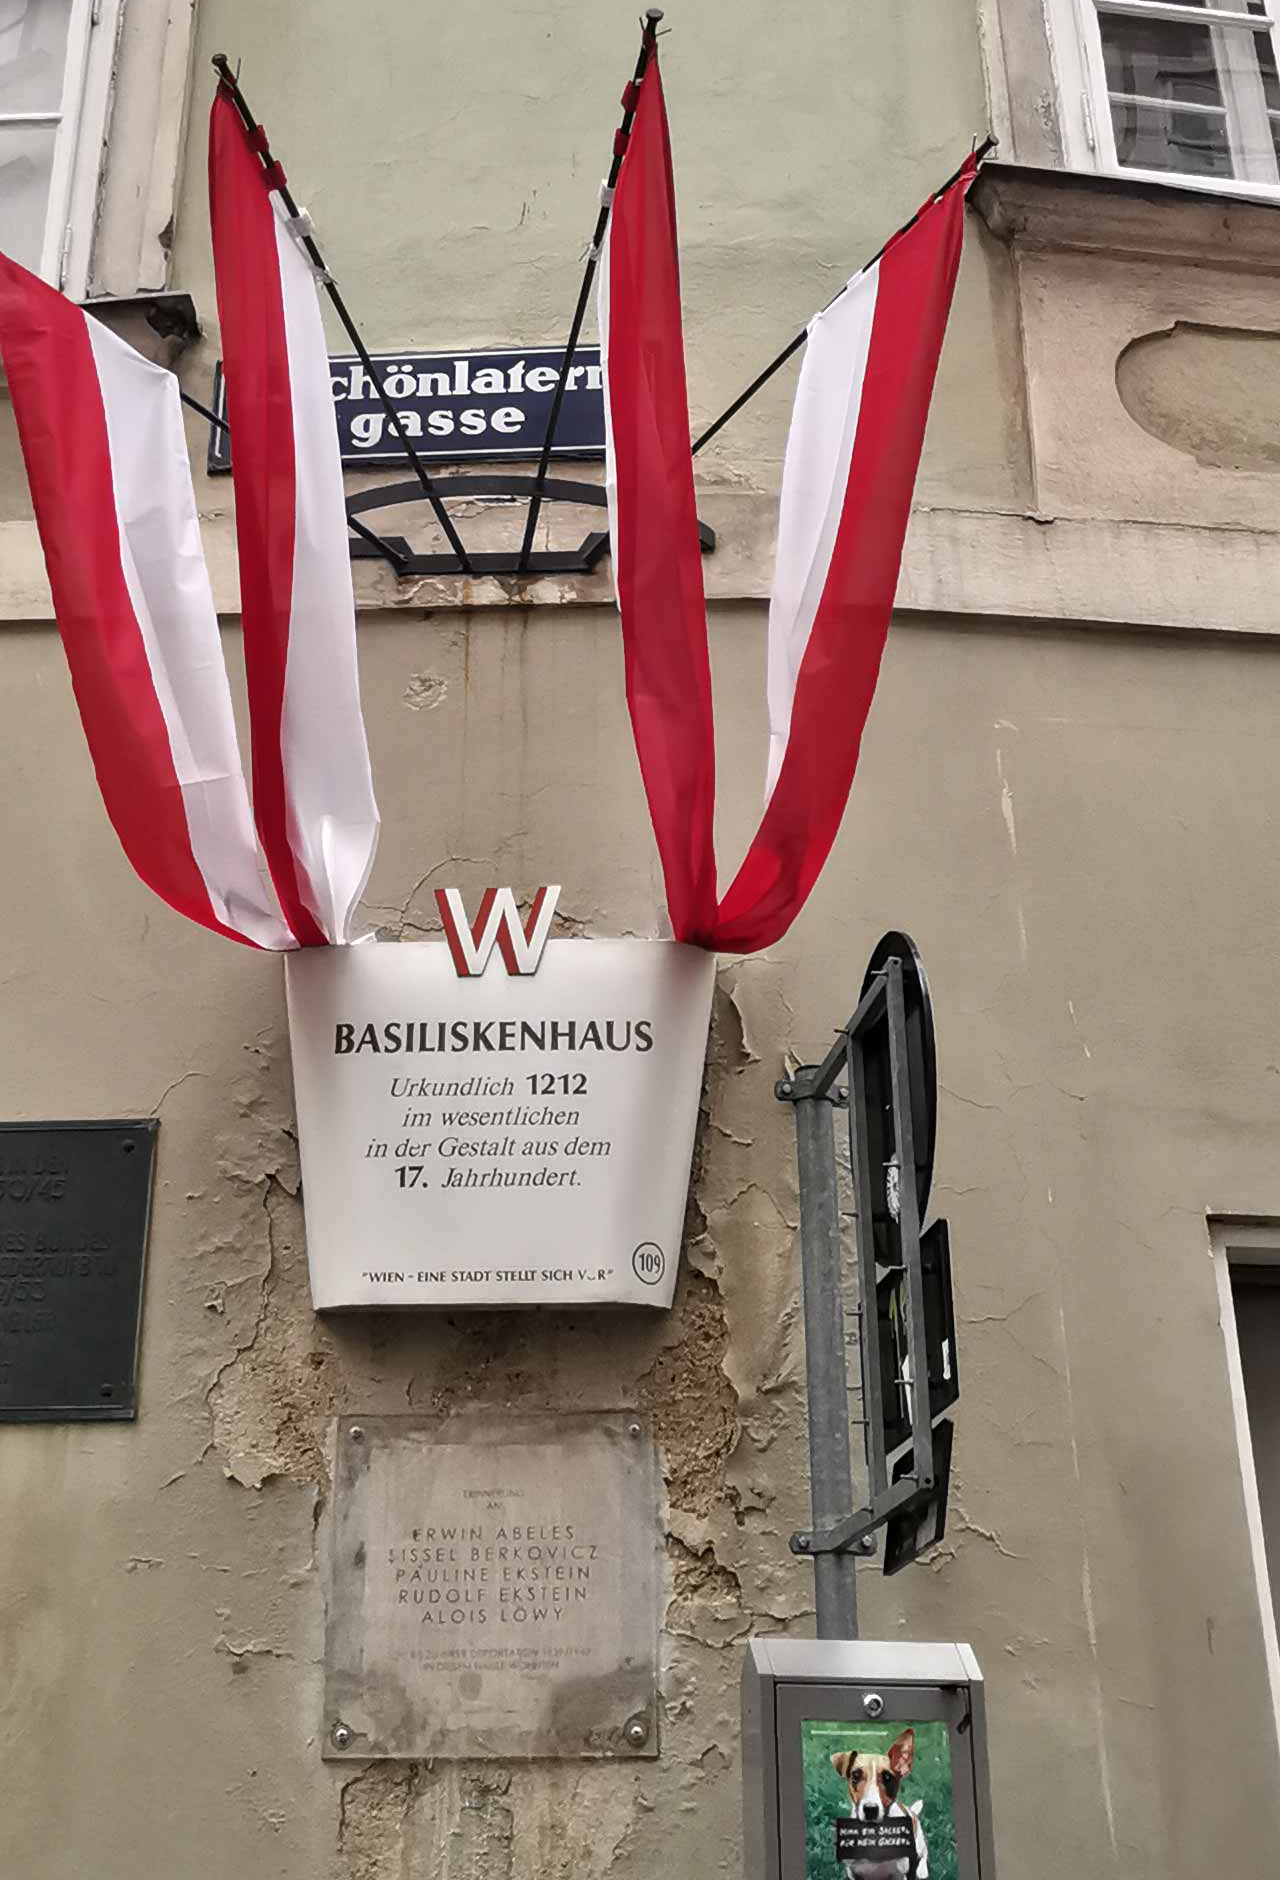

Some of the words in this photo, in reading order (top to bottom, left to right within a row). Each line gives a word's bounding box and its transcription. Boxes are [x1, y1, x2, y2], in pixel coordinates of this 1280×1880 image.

[350, 406, 526, 448] gasse
[434, 885, 561, 978] W
[334, 1020, 655, 1055] BASILISKENHAUS
[389, 1076, 515, 1099] Urkundlich
[525, 1072, 588, 1096] 1212
[401, 1108, 432, 1127] im
[440, 1106, 580, 1128] wesentlichen
[364, 1138, 389, 1159] in
[393, 1138, 432, 1158] der
[437, 1136, 516, 1158] Gestalt
[521, 1141, 559, 1157] aus
[563, 1136, 611, 1157] dem
[393, 1165, 428, 1189] 17.
[440, 1165, 582, 1189] Jahrhundert.
[637, 1252, 662, 1274] 109
[417, 1270, 447, 1283] EINE
[451, 1270, 491, 1283] STADT
[495, 1269, 537, 1282] STELLT
[541, 1269, 573, 1282] SICH
[412, 1526, 483, 1544] ERWIN
[495, 1526, 576, 1541] ABELES
[470, 1545, 599, 1562] BERKOVICZ
[395, 1567, 490, 1583] PAULINE
[502, 1566, 591, 1582] EKSTEIN
[398, 1589, 488, 1605] RUDOLF
[499, 1586, 588, 1603] EKSTEIN
[421, 1608, 488, 1624] ALOIS
